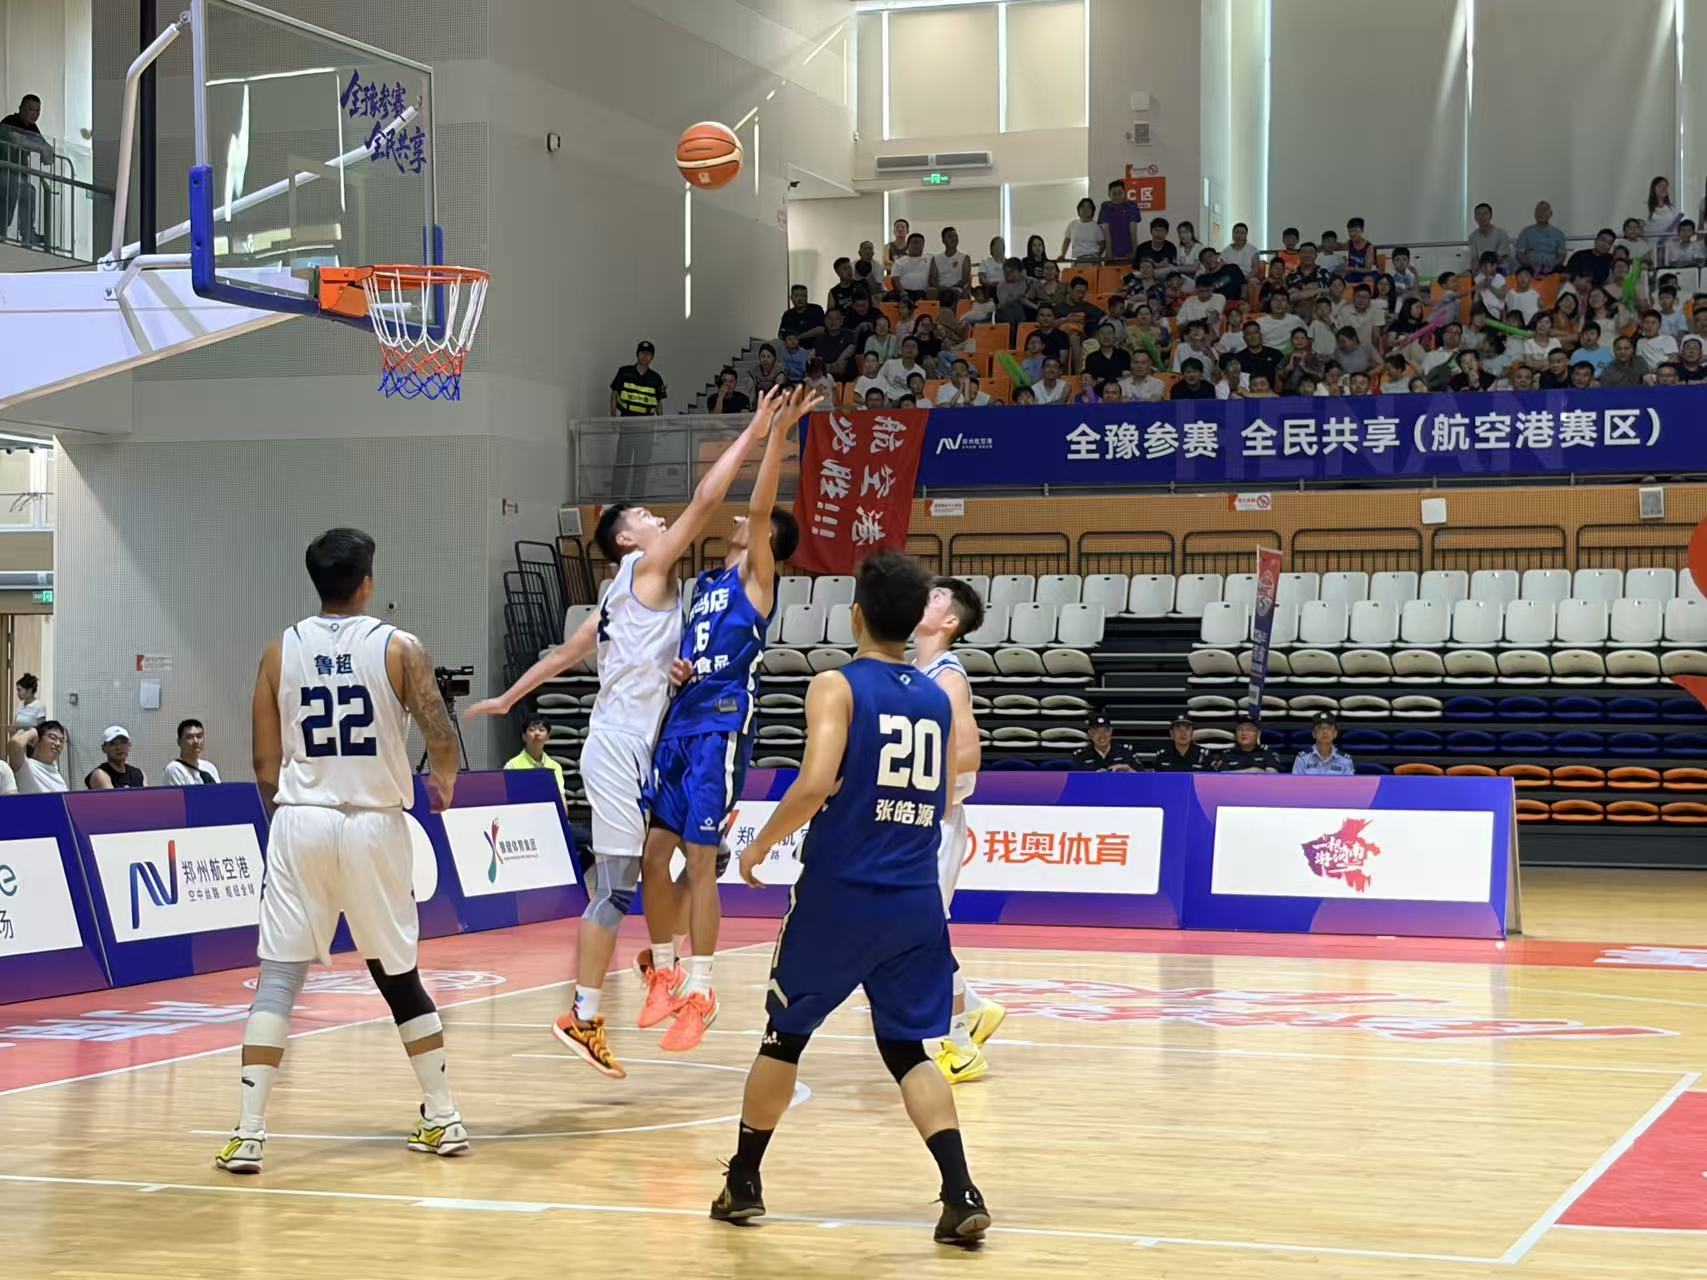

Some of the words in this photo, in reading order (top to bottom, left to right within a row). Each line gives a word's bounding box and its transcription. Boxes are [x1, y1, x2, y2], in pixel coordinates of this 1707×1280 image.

[364, 121, 427, 173] 全民共享
[1065, 420, 1220, 460] 全豫参赛
[689, 587, 730, 624] 马店
[314, 653, 354, 676] 鲁超
[300, 685, 378, 758] 22
[876, 713, 942, 792] 20
[983, 830, 1131, 867] 我奥体育
[181, 856, 251, 884] 郑州航空港
